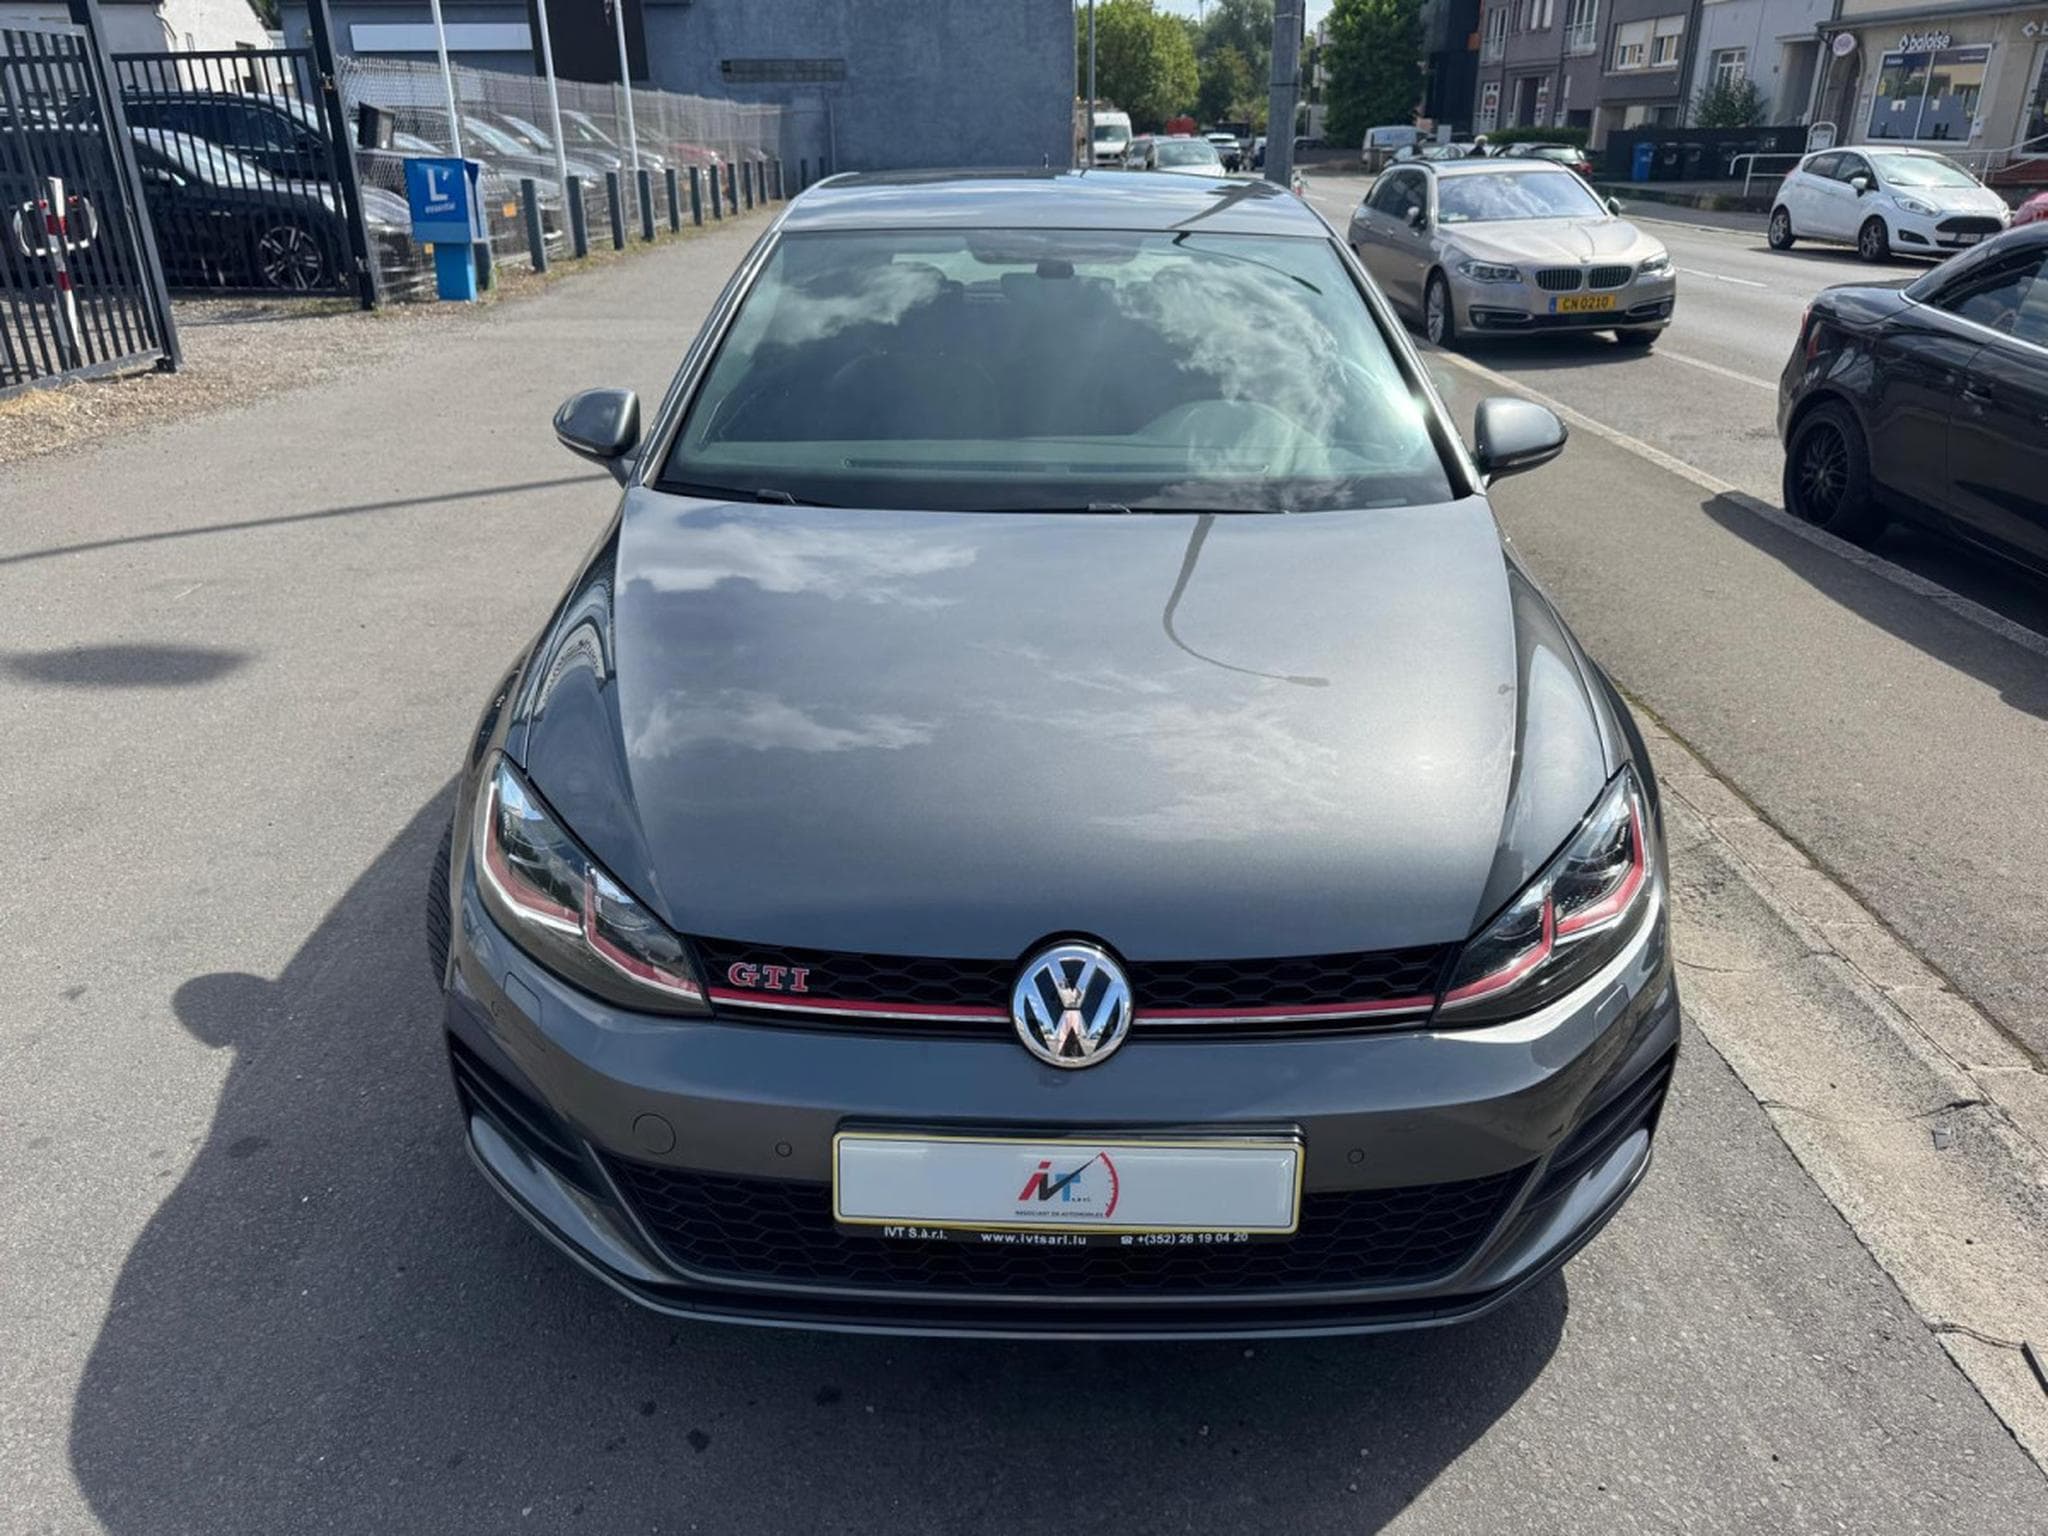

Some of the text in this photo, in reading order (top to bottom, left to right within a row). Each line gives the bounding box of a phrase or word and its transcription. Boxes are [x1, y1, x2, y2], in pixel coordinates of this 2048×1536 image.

[728, 962, 809, 992] GTI
[883, 1226, 905, 1239] IVT
[980, 1233, 1087, 1246] www.ivtsarl.lu
[1136, 1234, 1175, 1246] +(352)
[1178, 1233, 1194, 1244] 26
[1198, 1233, 1212, 1244] 19
[1214, 1232, 1230, 1243] 04
[1233, 1231, 1249, 1243] 20
